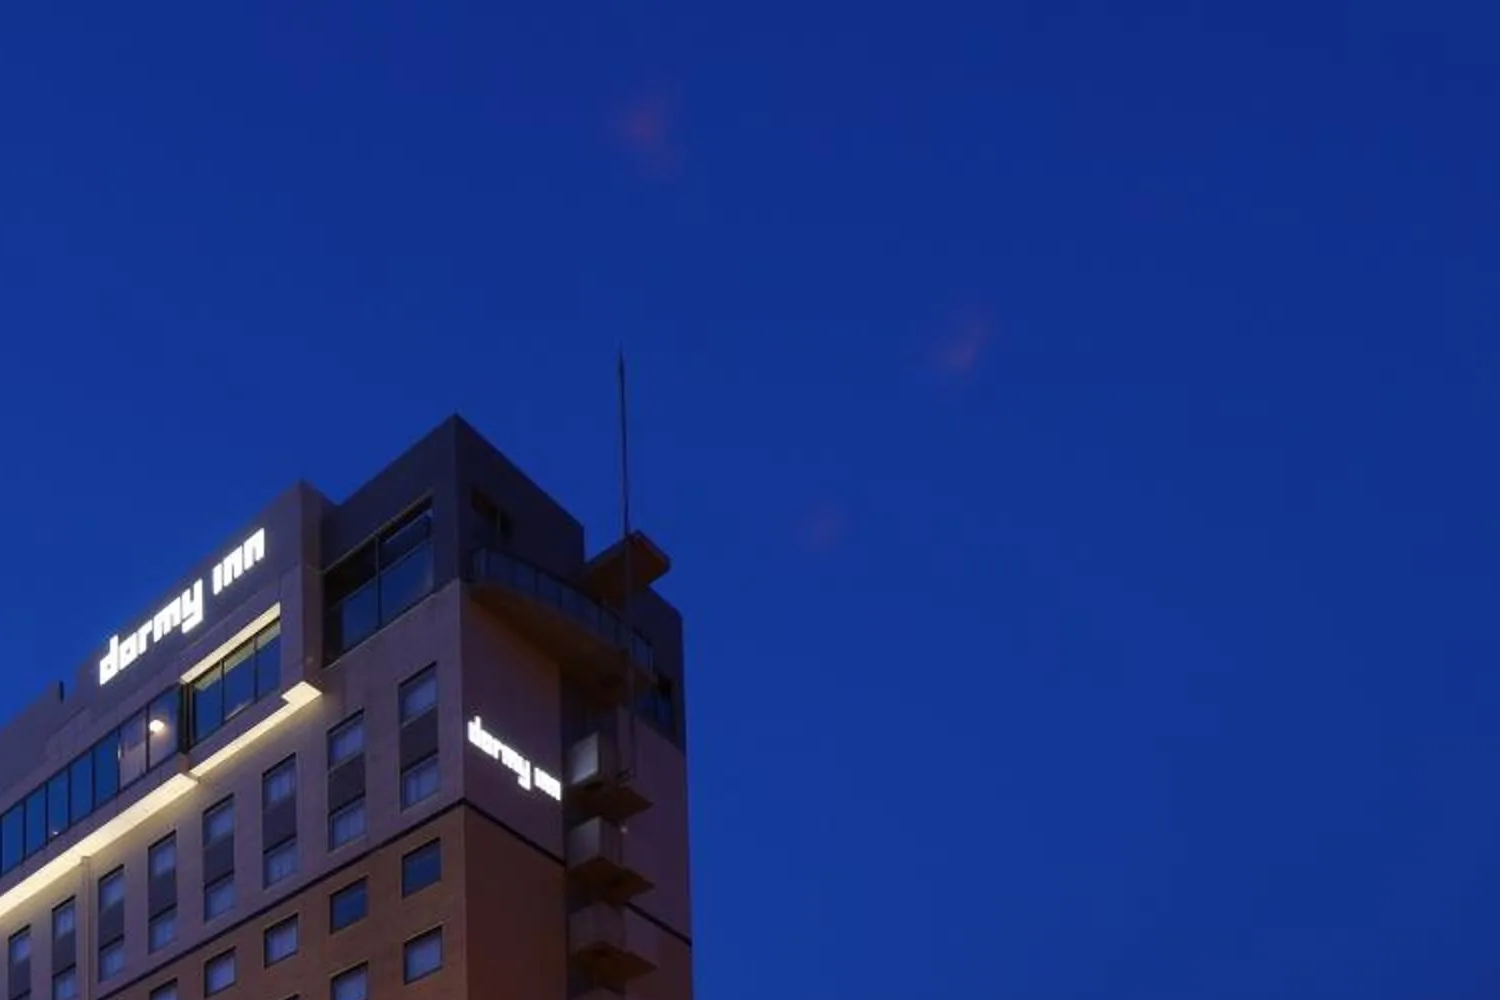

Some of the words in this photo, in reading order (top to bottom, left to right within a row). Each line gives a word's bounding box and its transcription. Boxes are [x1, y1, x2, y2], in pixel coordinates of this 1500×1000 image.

[99, 578, 203, 685] dormy
[212, 528, 266, 595] inn
[467, 716, 532, 791] dormy
